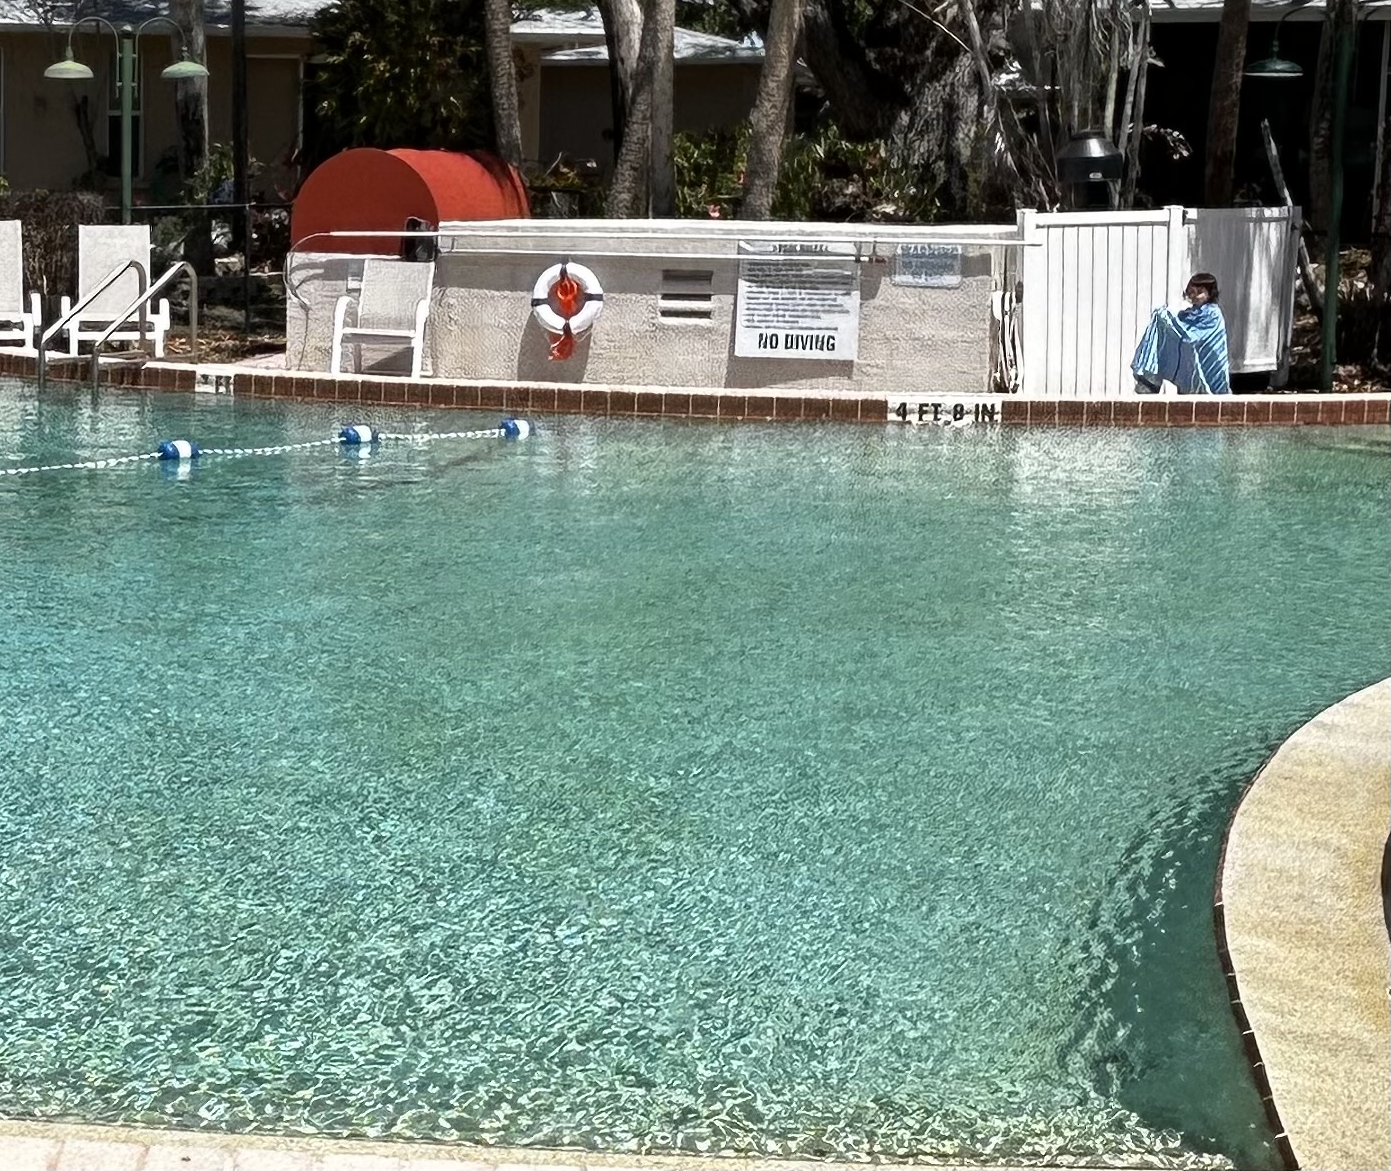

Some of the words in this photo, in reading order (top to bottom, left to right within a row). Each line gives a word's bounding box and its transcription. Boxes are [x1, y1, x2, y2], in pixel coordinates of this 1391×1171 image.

[758, 332, 779, 350] NO
[784, 333, 836, 351] DIVING
[896, 401, 908, 421] 4
[952, 402, 965, 422] 8
